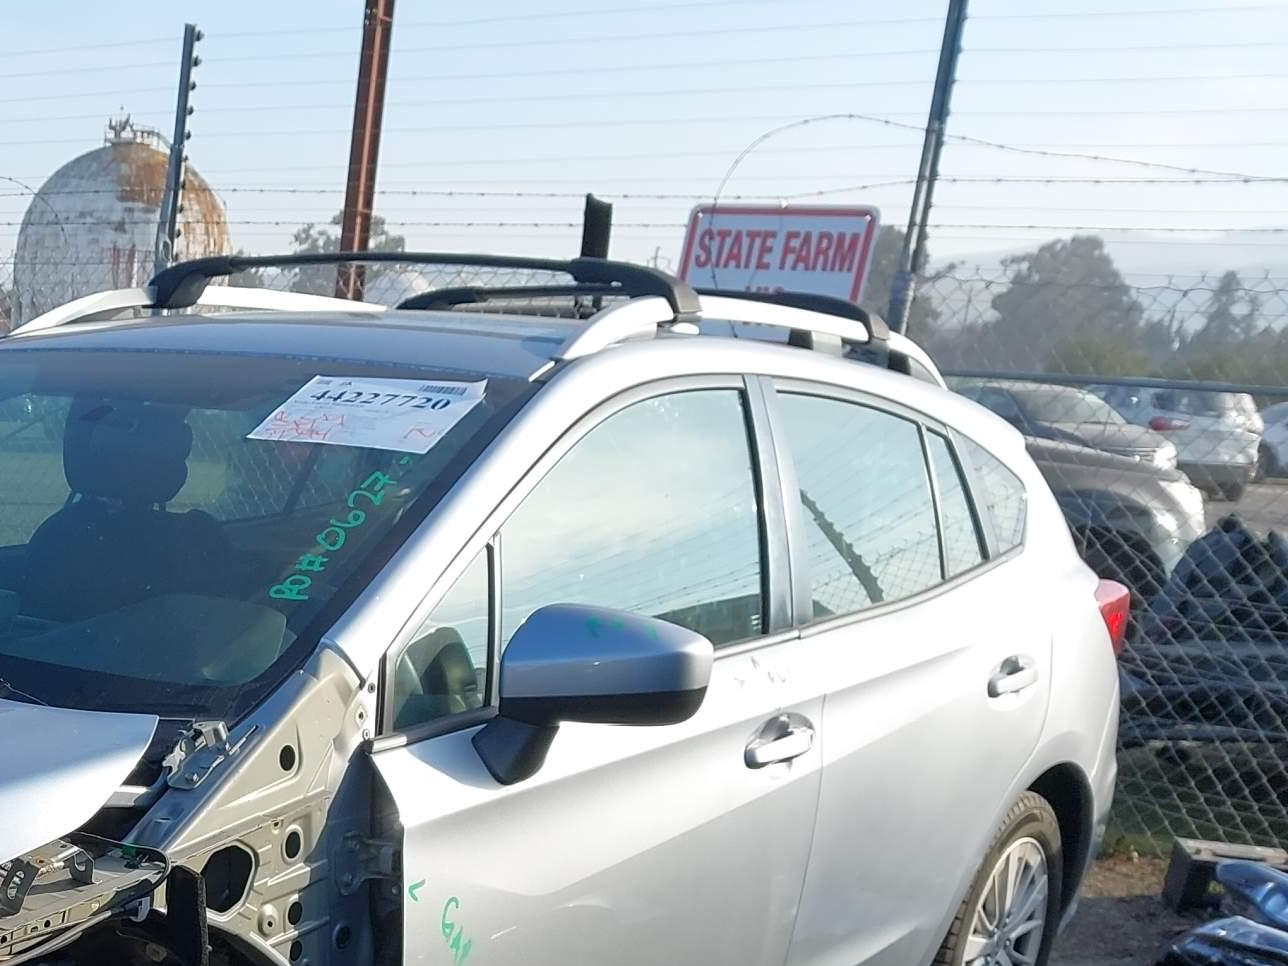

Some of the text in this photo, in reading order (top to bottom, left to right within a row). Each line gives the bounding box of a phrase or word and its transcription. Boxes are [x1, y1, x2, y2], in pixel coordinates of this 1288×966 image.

[694, 228, 861, 273] STATE FARM
[310, 389, 451, 412] 44227720
